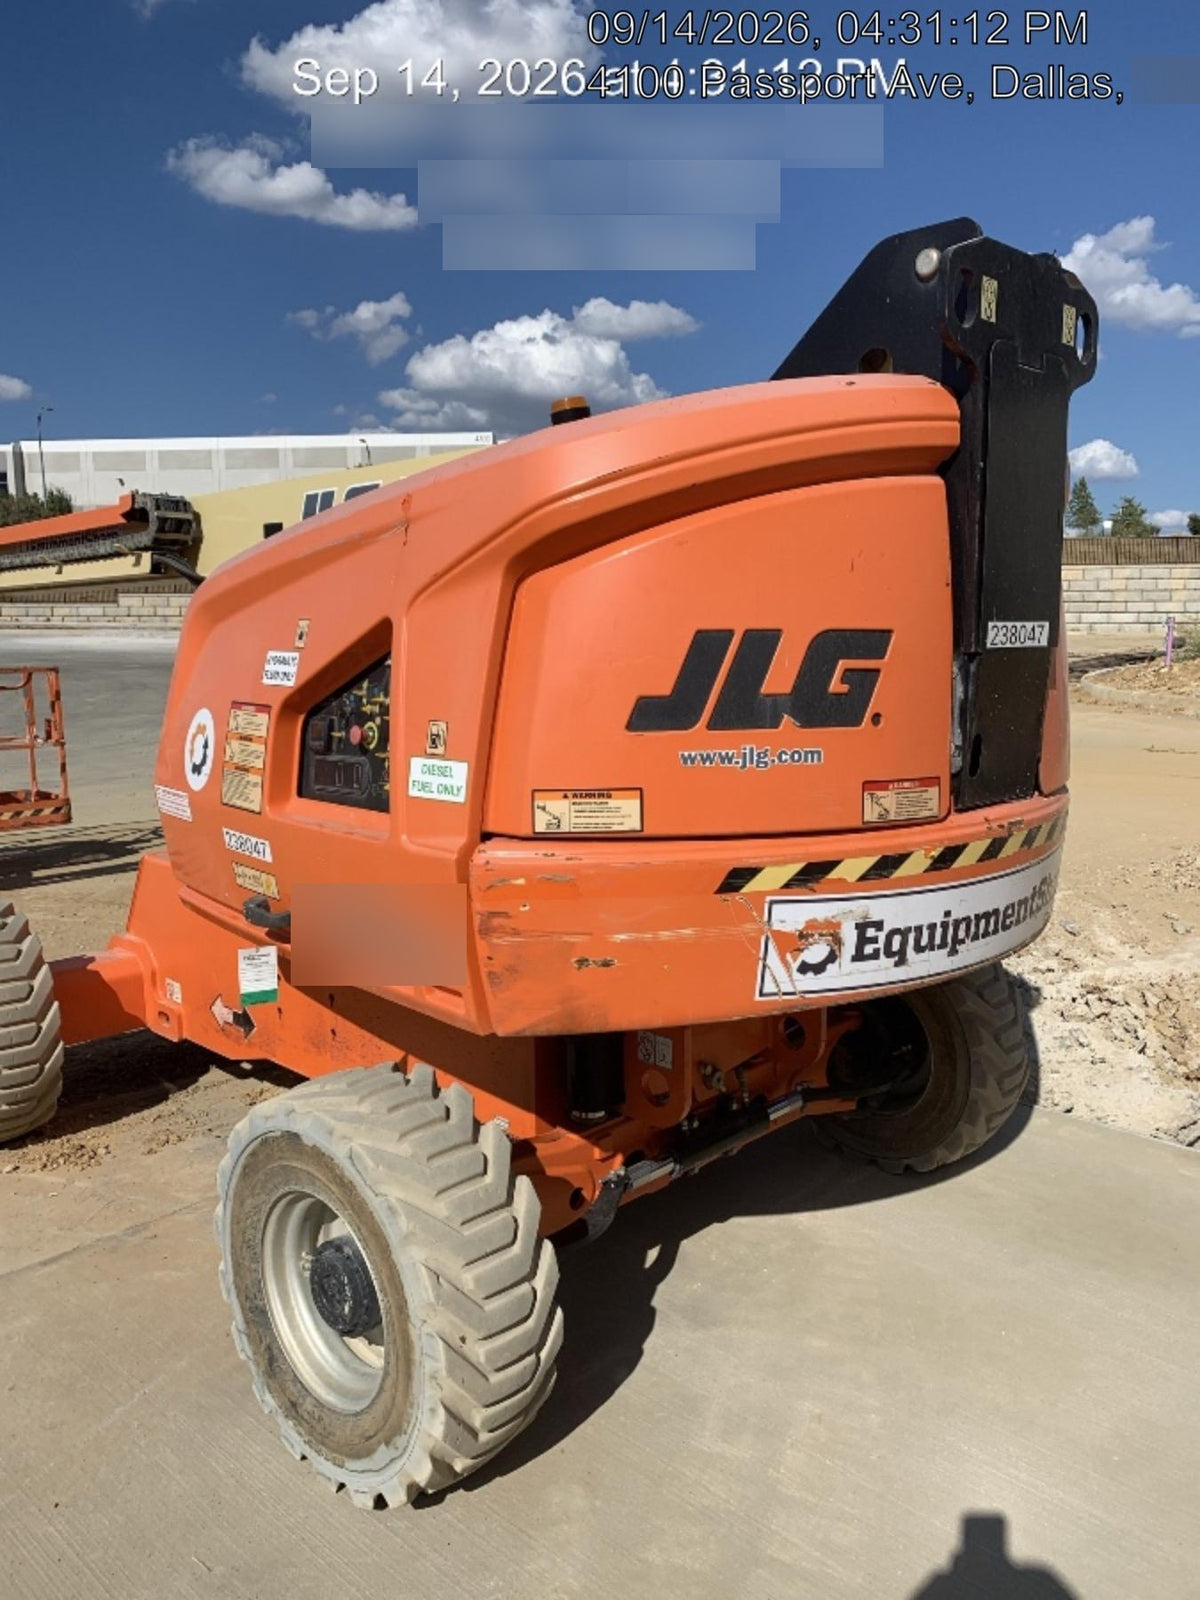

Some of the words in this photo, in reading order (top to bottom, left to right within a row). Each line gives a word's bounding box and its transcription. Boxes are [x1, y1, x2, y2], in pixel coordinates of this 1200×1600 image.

[989, 624, 1045, 646] 238047
[625, 628, 894, 732] JLG
[679, 747, 823, 769] www.jlg.com
[421, 763, 454, 778] DIESEL
[412, 779, 434, 793] FUEL
[436, 783, 463, 797] ONLY
